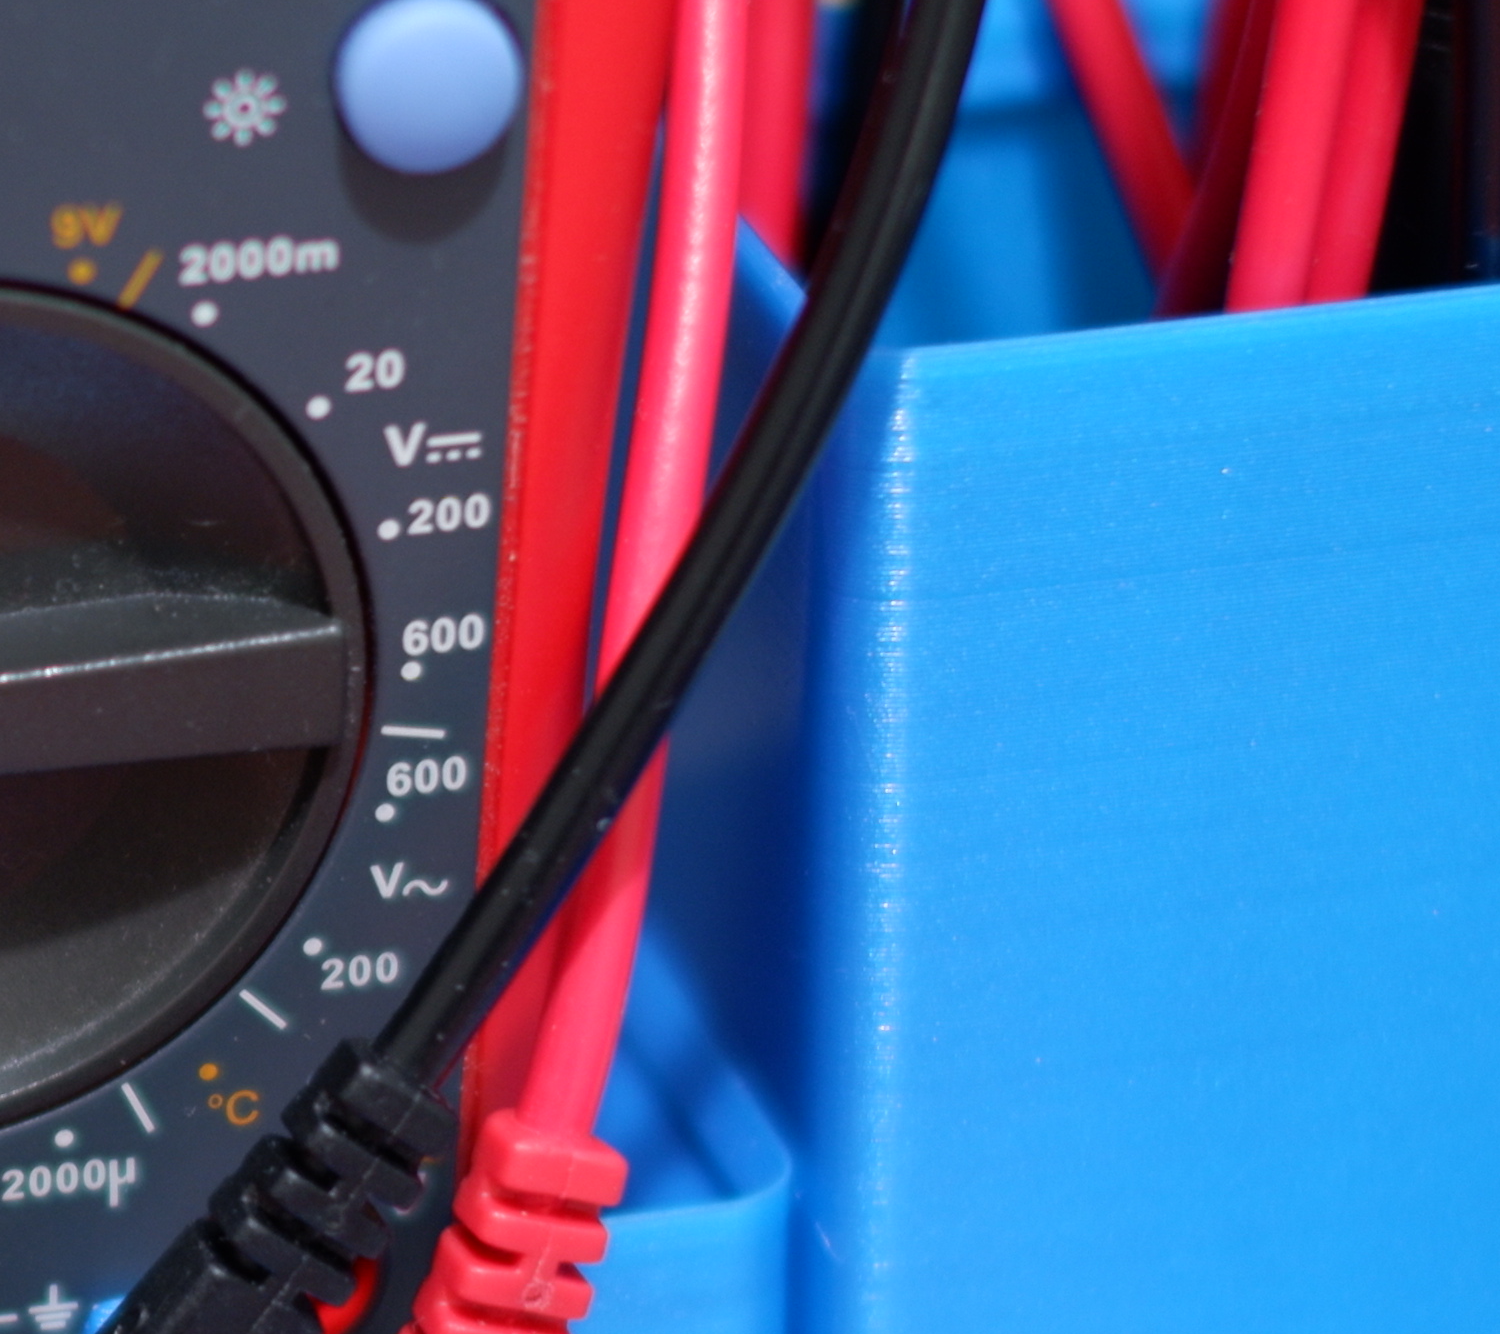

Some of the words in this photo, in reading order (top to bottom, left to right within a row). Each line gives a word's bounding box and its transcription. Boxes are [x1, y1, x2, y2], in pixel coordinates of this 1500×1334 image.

[50, 202, 122, 249] 9V
[178, 235, 341, 287] 2000m
[344, 348, 406, 394] 20
[407, 492, 492, 536] 200
[402, 613, 486, 657] 600
[386, 755, 468, 798] 600
[320, 951, 400, 991] 200
[207, 1089, 260, 1127] °C
